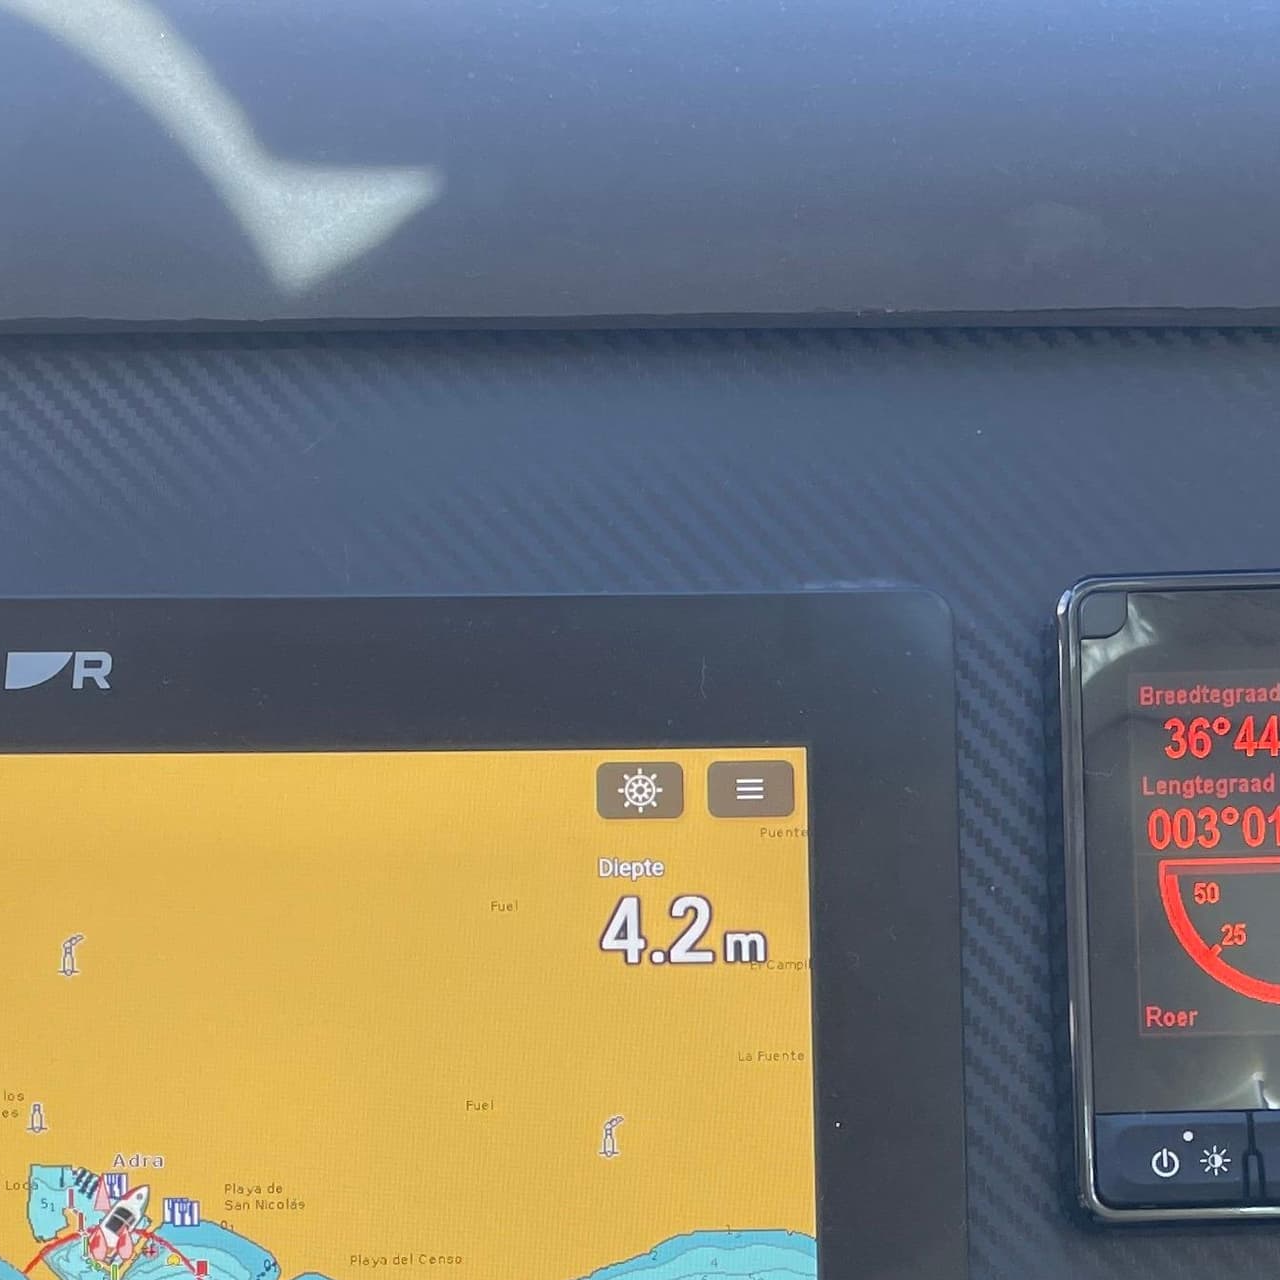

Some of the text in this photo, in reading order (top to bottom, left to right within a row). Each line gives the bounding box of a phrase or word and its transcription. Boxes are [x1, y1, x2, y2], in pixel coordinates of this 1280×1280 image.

[1140, 682, 1280, 706] Breedtegraad
[1142, 774, 1275, 798] Lengtegraad
[598, 857, 666, 881] Diepte
[1193, 881, 1220, 904] 50
[599, 894, 768, 965] 4.2 m
[1220, 922, 1247, 946] 25
[1144, 1005, 1198, 1028] Roer
[112, 1153, 165, 1169] Adra
